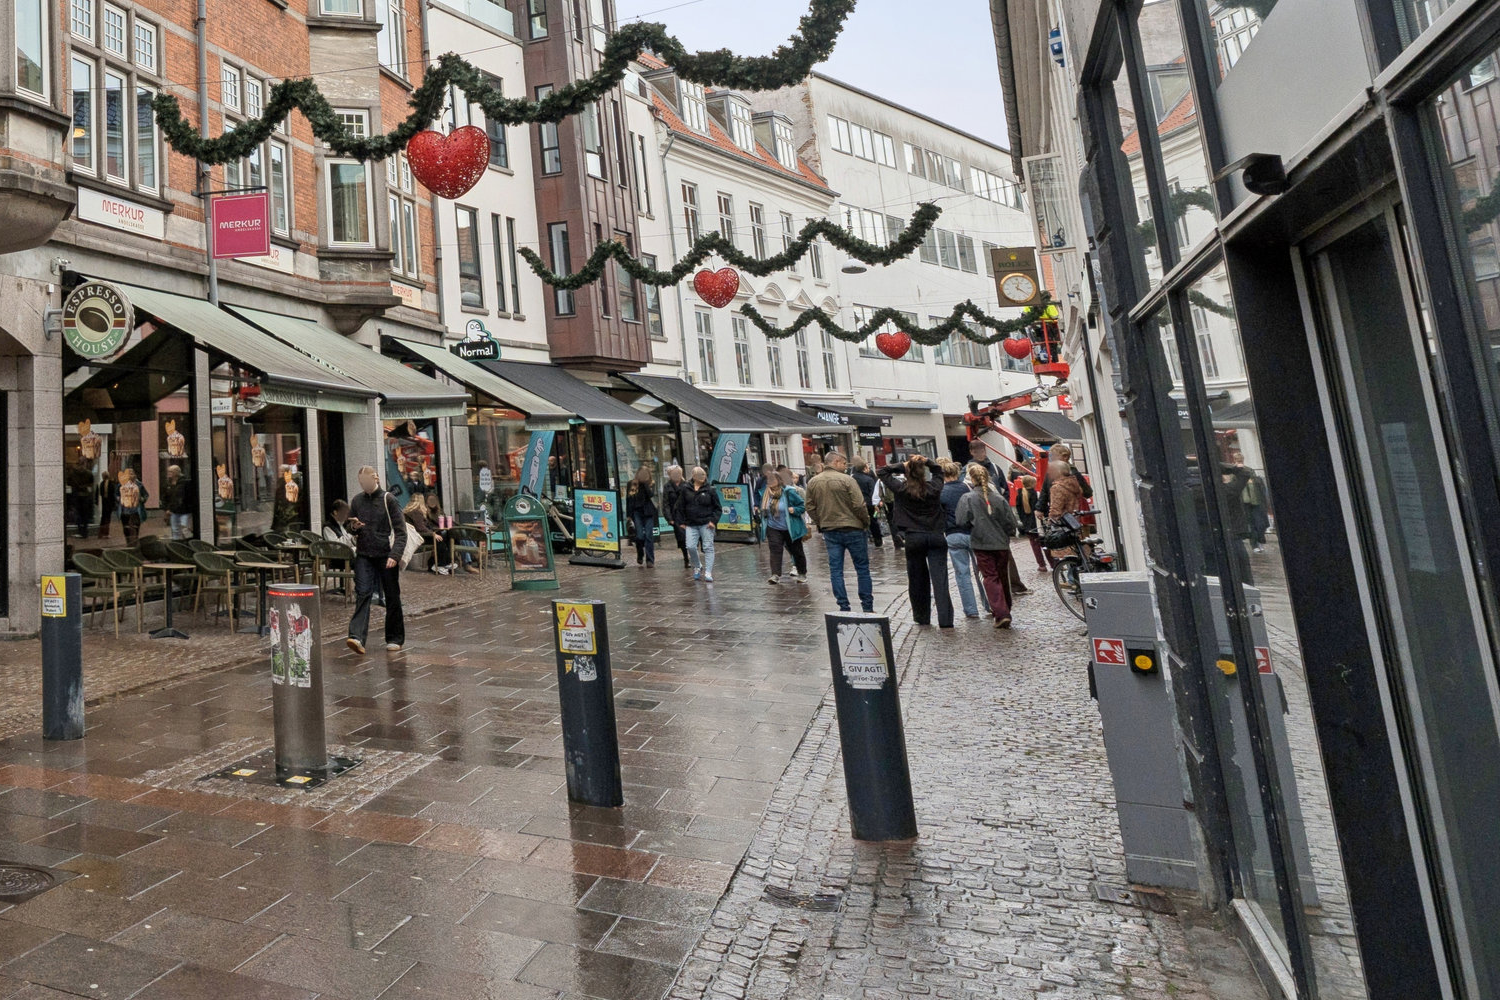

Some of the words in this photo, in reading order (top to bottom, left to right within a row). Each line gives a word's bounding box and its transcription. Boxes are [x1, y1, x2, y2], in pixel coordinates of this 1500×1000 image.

[102, 199, 145, 223] MERKUR
[219, 219, 261, 229] MERKUR
[67, 286, 123, 314] ESPRESSO
[73, 335, 116, 354] HOUSE
[460, 345, 493, 357] Normal
[817, 411, 840, 424] CHANGE
[849, 665, 862, 673] GIV
